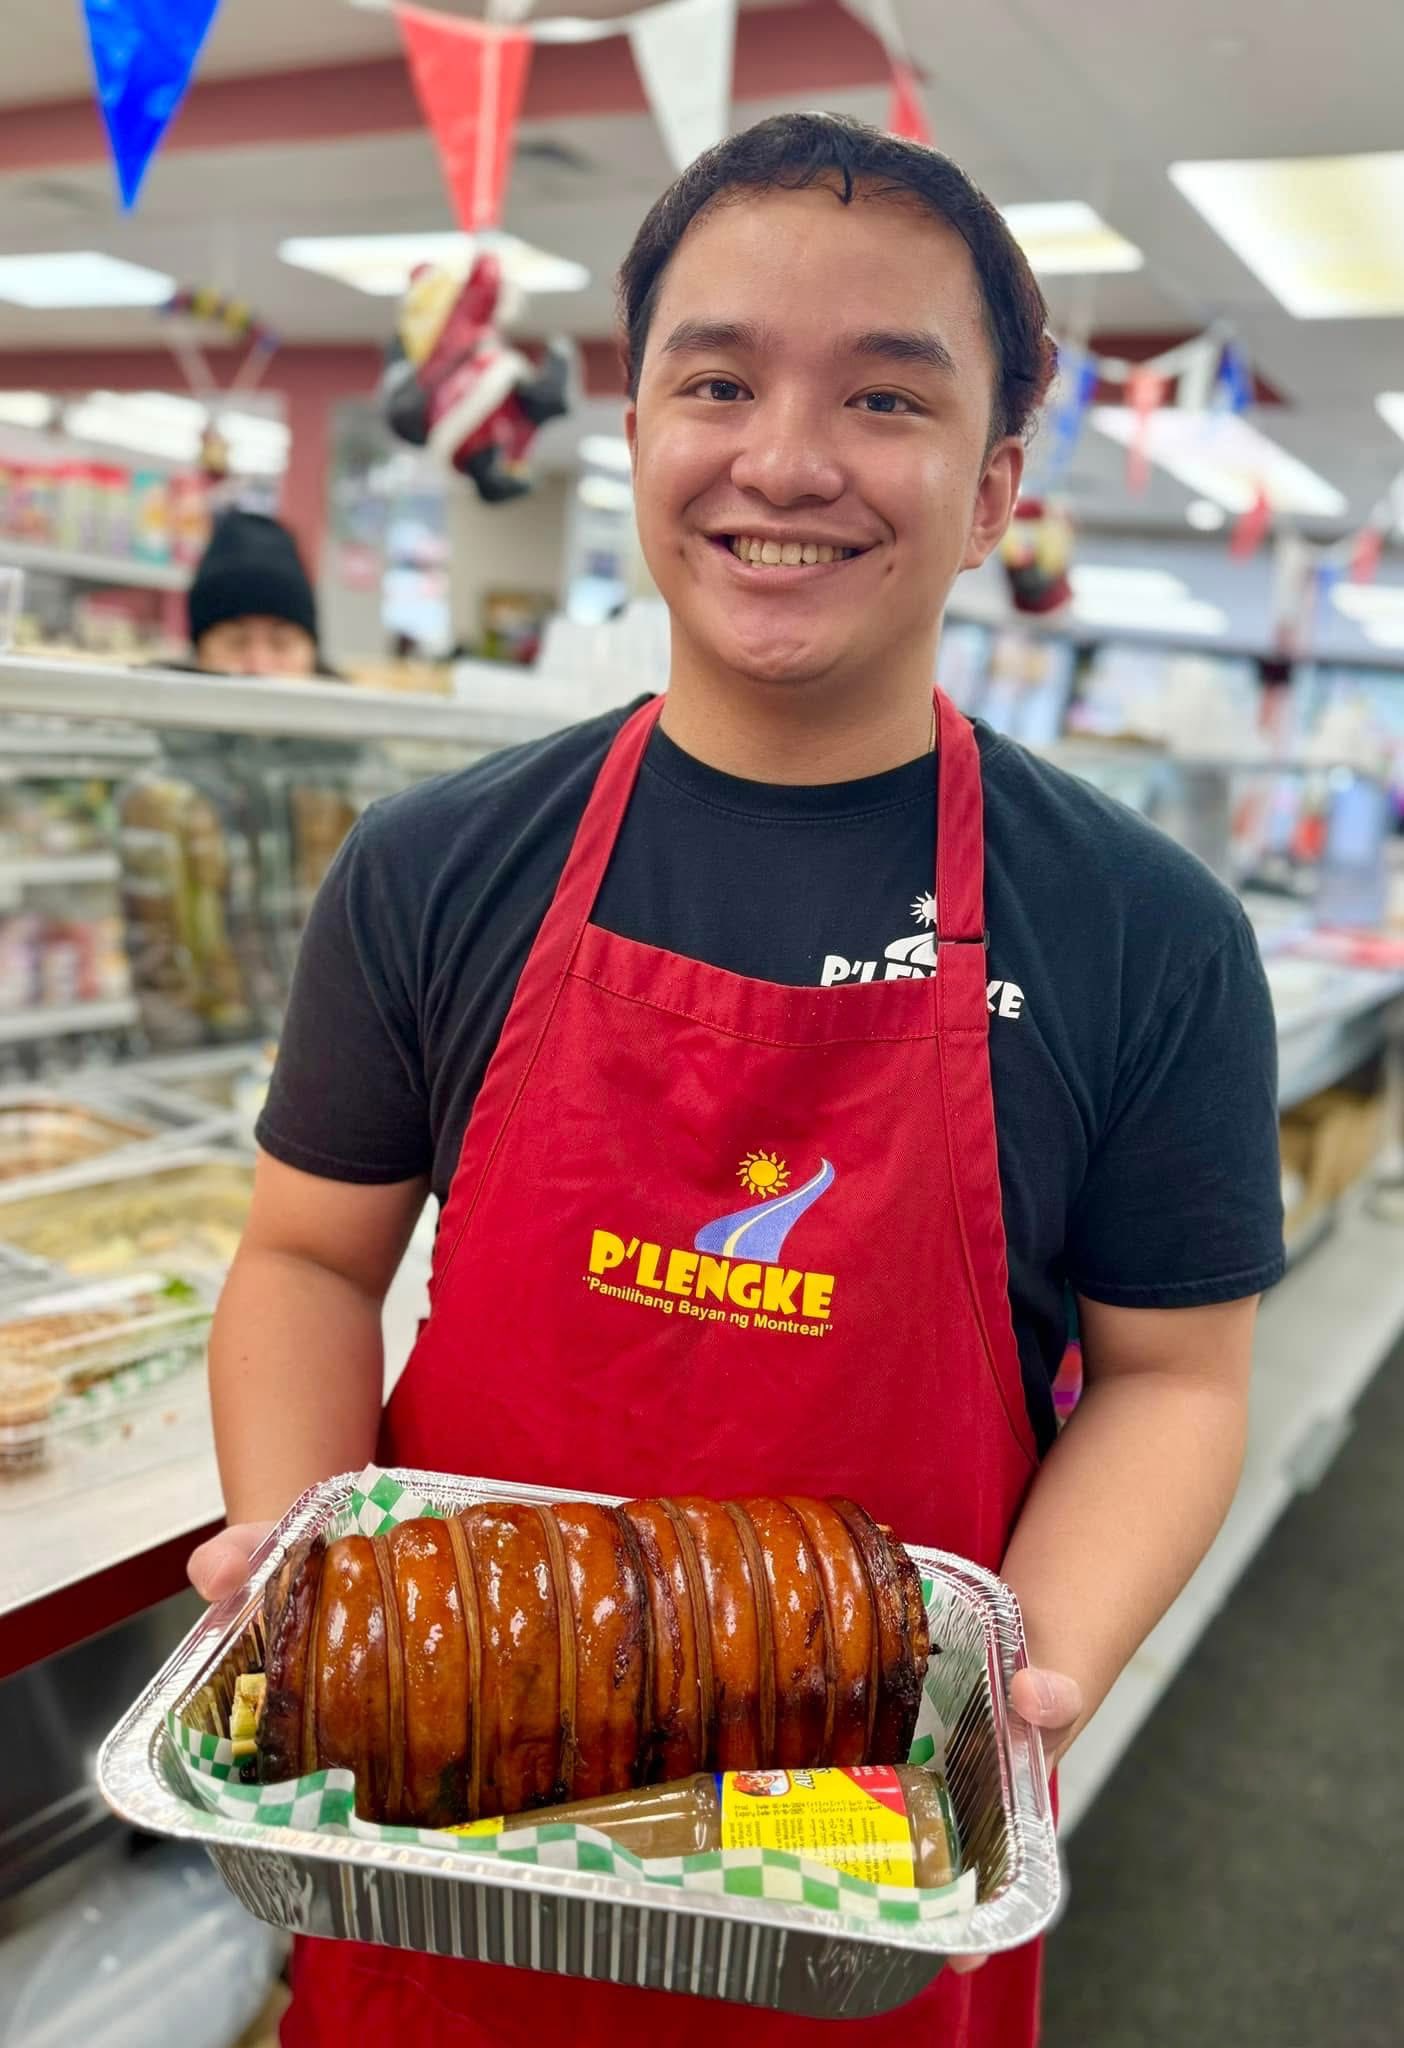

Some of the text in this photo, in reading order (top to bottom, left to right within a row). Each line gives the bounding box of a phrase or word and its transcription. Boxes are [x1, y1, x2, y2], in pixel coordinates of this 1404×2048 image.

[582, 1275, 833, 1337] "Pamilihang Bayan ng Montreal"
[588, 1229, 835, 1319] P'LENGKE
